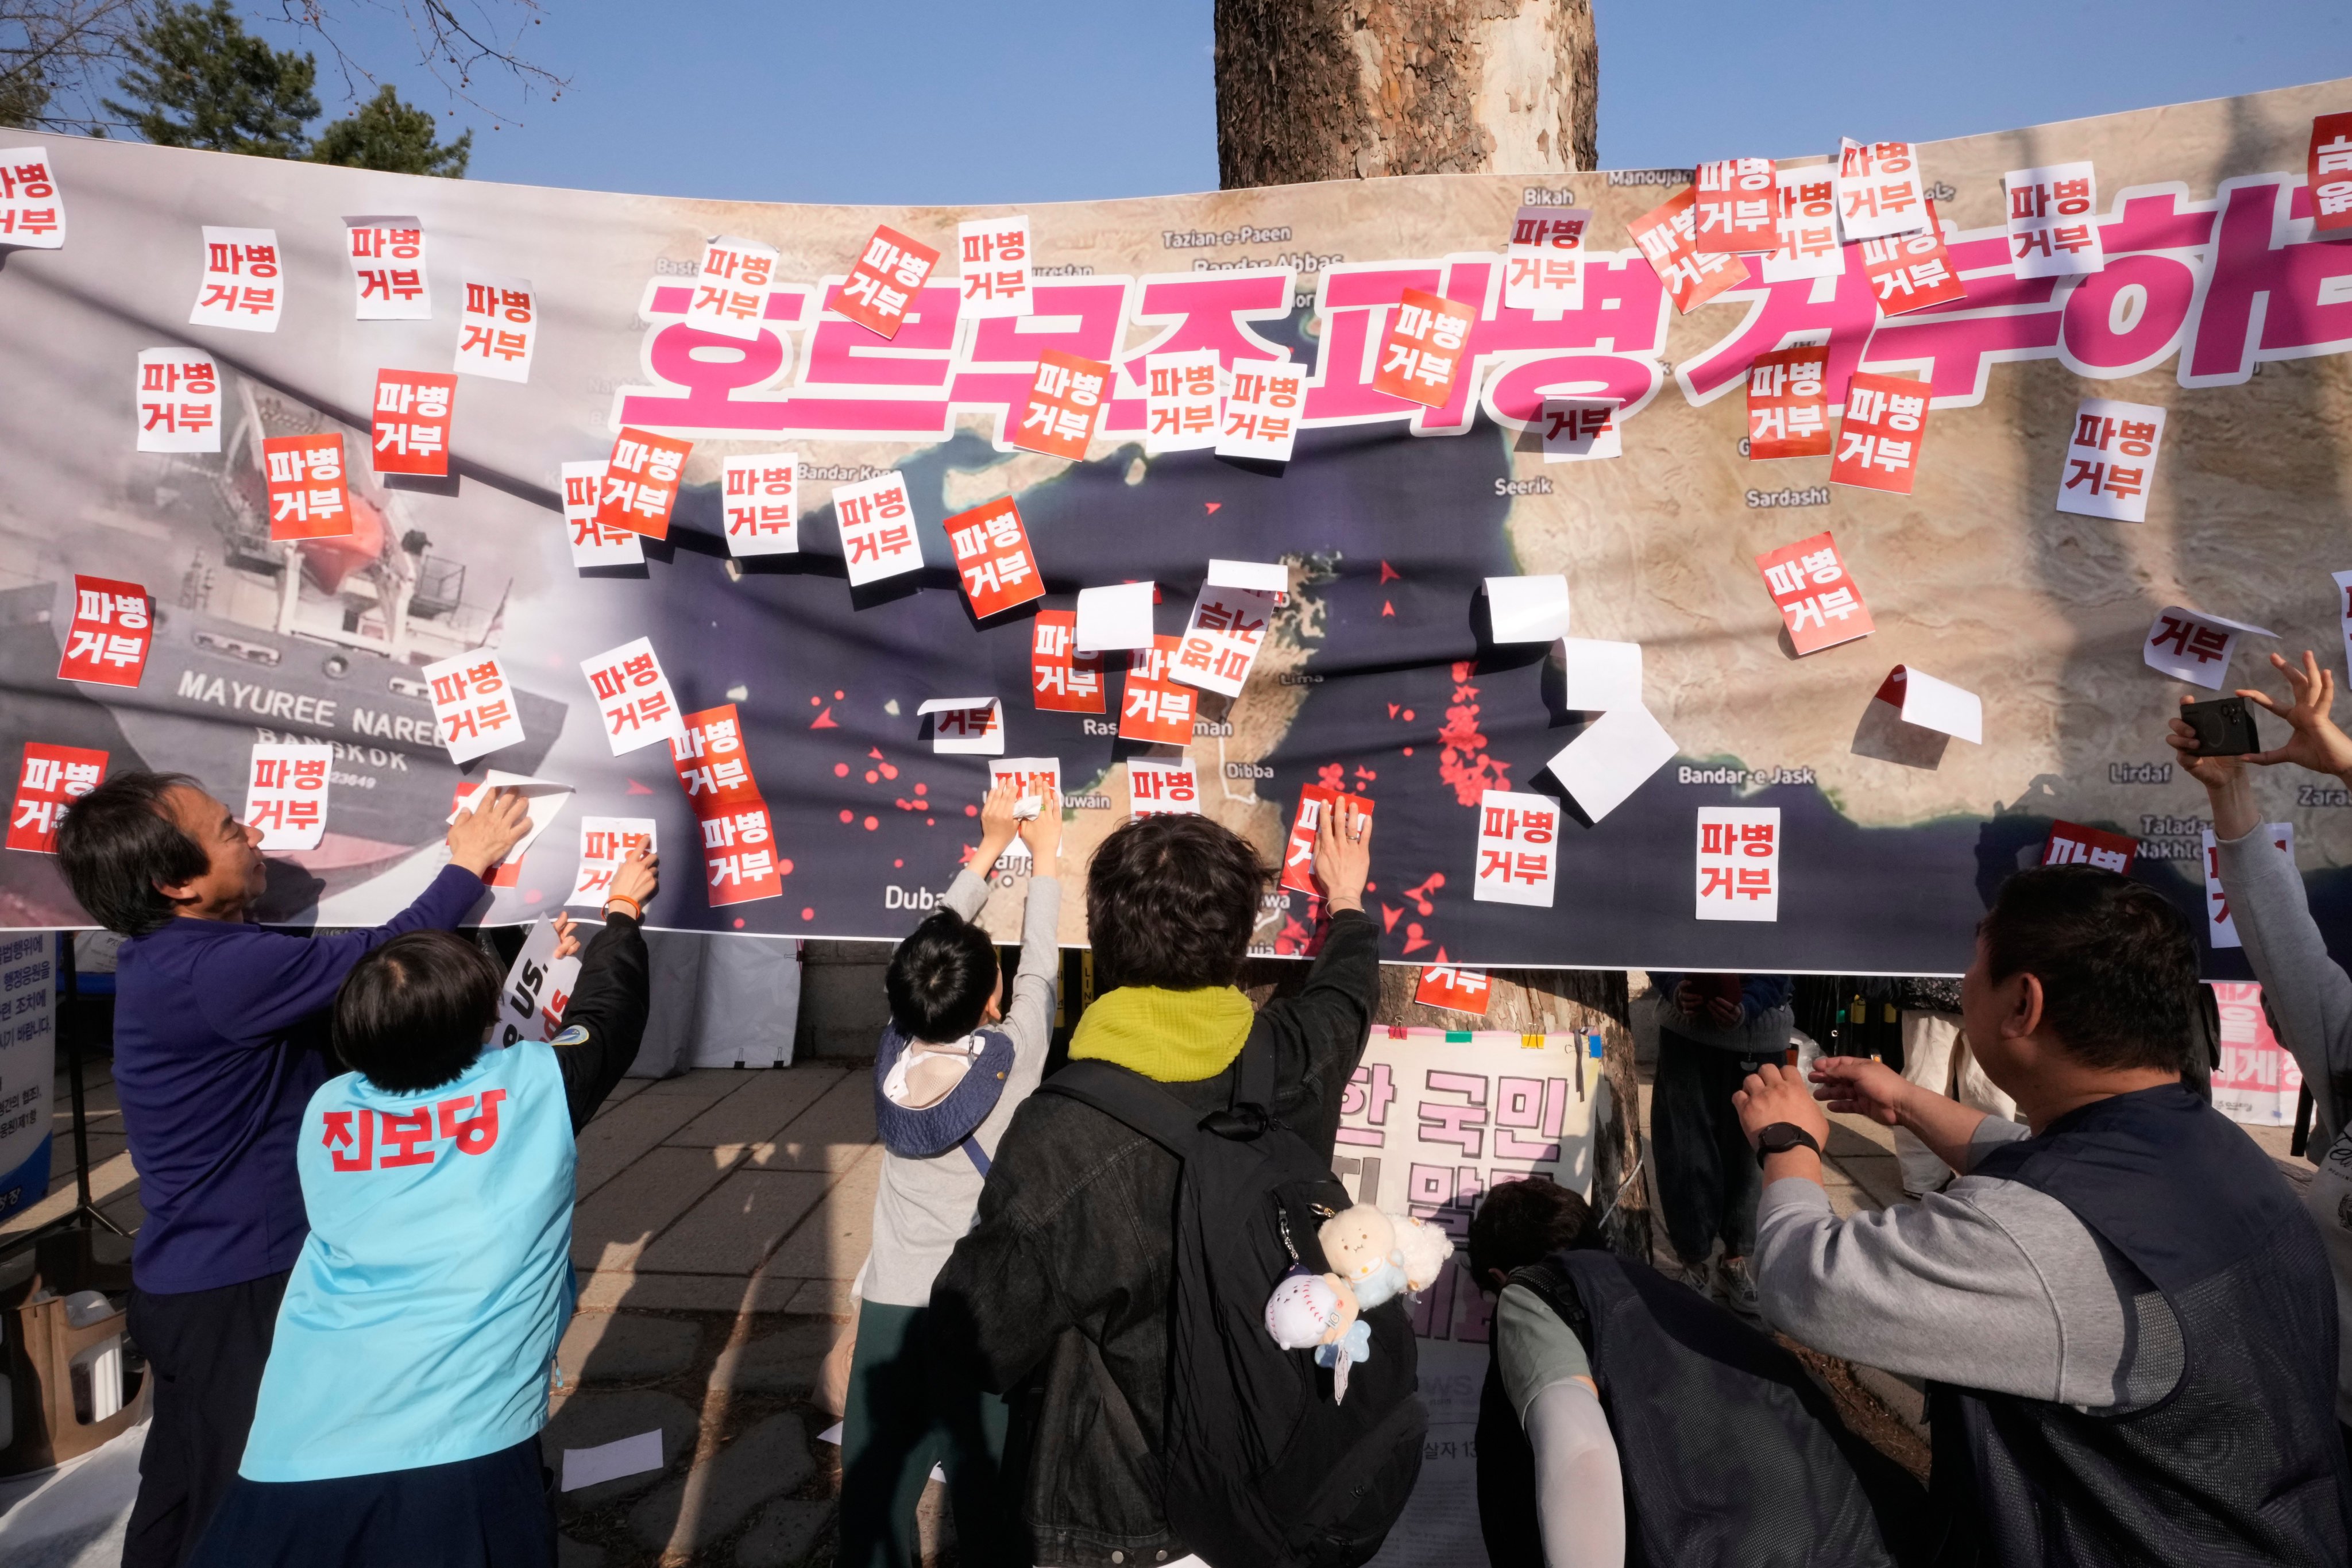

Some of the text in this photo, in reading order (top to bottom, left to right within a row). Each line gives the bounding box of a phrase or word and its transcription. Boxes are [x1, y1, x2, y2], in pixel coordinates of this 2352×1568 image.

[1698, 158, 1769, 192] 파병
[1841, 142, 1911, 177] 파병
[1524, 189, 1574, 205] Bikah
[1843, 180, 1917, 219] 거부
[2011, 177, 2090, 219] 파병
[1700, 199, 1770, 233] 거부
[351, 229, 421, 260] 파병
[963, 231, 1025, 262] 파병
[1163, 227, 1291, 249] Tazian-e-Paeen
[1513, 219, 1584, 249] 파병
[2014, 225, 2093, 259] 거부
[209, 244, 277, 277] 파병
[704, 248, 772, 286] 파병
[862, 237, 930, 287] 파병
[1510, 258, 1577, 289] 거부
[1660, 253, 1731, 294] 거부
[357, 269, 424, 300] 거부
[844, 272, 908, 317] 거부
[964, 269, 1025, 301] 거부
[1872, 259, 1950, 299] 거부
[200, 285, 275, 319] 거부
[466, 283, 532, 324] 파병
[694, 285, 763, 320] 거부
[460, 324, 526, 361] 거부
[1394, 304, 1467, 350] 파병
[141, 362, 217, 395] 파병
[1150, 364, 1214, 397] 파병
[1383, 344, 1454, 387] 거부
[1751, 361, 1822, 397] 파병
[378, 382, 449, 418] 파병
[1033, 364, 1103, 407] 파병
[1232, 373, 1299, 408] 파병
[142, 403, 213, 433] 거부
[1024, 402, 1090, 441] 거부
[1151, 404, 1214, 435] 거부
[1223, 412, 1289, 443] 거부
[1546, 408, 1613, 442] 거부
[1752, 405, 1824, 439] 거부
[1847, 388, 1924, 432] 파병
[375, 423, 442, 456] 거부
[2074, 413, 2156, 458] 파병
[267, 447, 341, 482] 파병
[612, 439, 683, 482] 파병
[1838, 434, 1911, 473] 거부
[727, 466, 791, 496] 파병
[798, 464, 854, 480] Bandar
[1495, 478, 1553, 495] Seerik
[2065, 459, 2142, 500] 거부
[273, 487, 344, 522] 거부
[565, 477, 601, 507] 파
[601, 477, 669, 519] 거부
[839, 486, 906, 527] 파병
[1747, 488, 1830, 508] Sardasht
[729, 504, 790, 536] 거부
[952, 512, 1021, 560] 파병
[847, 527, 912, 565] 거부
[964, 551, 1032, 597] 거부
[1764, 547, 1843, 597] 파병
[78, 589, 148, 630] 파병
[1782, 587, 1859, 632] 거부
[68, 630, 141, 668] 거부
[2151, 615, 2230, 664] 거부
[590, 652, 659, 701] 파병
[1037, 666, 1099, 697] 거부
[1131, 647, 1172, 681] 파
[1281, 673, 1324, 684] Lima
[177, 670, 337, 727] MAYUREE
[431, 661, 503, 706] 파병
[443, 705, 512, 742] 거부
[607, 698, 671, 736] 거부
[937, 708, 998, 735] 거부
[1125, 690, 1191, 725] 거부
[673, 718, 739, 762] 파병
[1084, 720, 1118, 734] Ras
[21, 758, 101, 795] 파병
[254, 759, 326, 791] 파병
[681, 758, 747, 796] 거부
[1133, 772, 1195, 801] 파병
[1227, 764, 1273, 778] Dibba
[1678, 766, 1814, 785] Bandar-e Jask
[2110, 764, 2172, 784] Lirdaf
[13, 802, 59, 833] 거
[249, 801, 319, 830] 거부
[701, 811, 768, 848] 파병
[1484, 808, 1554, 844] 파병
[1701, 823, 1773, 857] 파병
[709, 849, 773, 887] 거부
[1480, 850, 1548, 885] 거부
[1701, 868, 1771, 900] 거부
[5, 960, 51, 991] 행정응원을
[1425, 966, 1487, 993] 거부
[0, 988, 46, 1022] 련 조치에
[17, 1015, 51, 1042] 바랍니다.
[322, 1089, 507, 1172] 진보당
